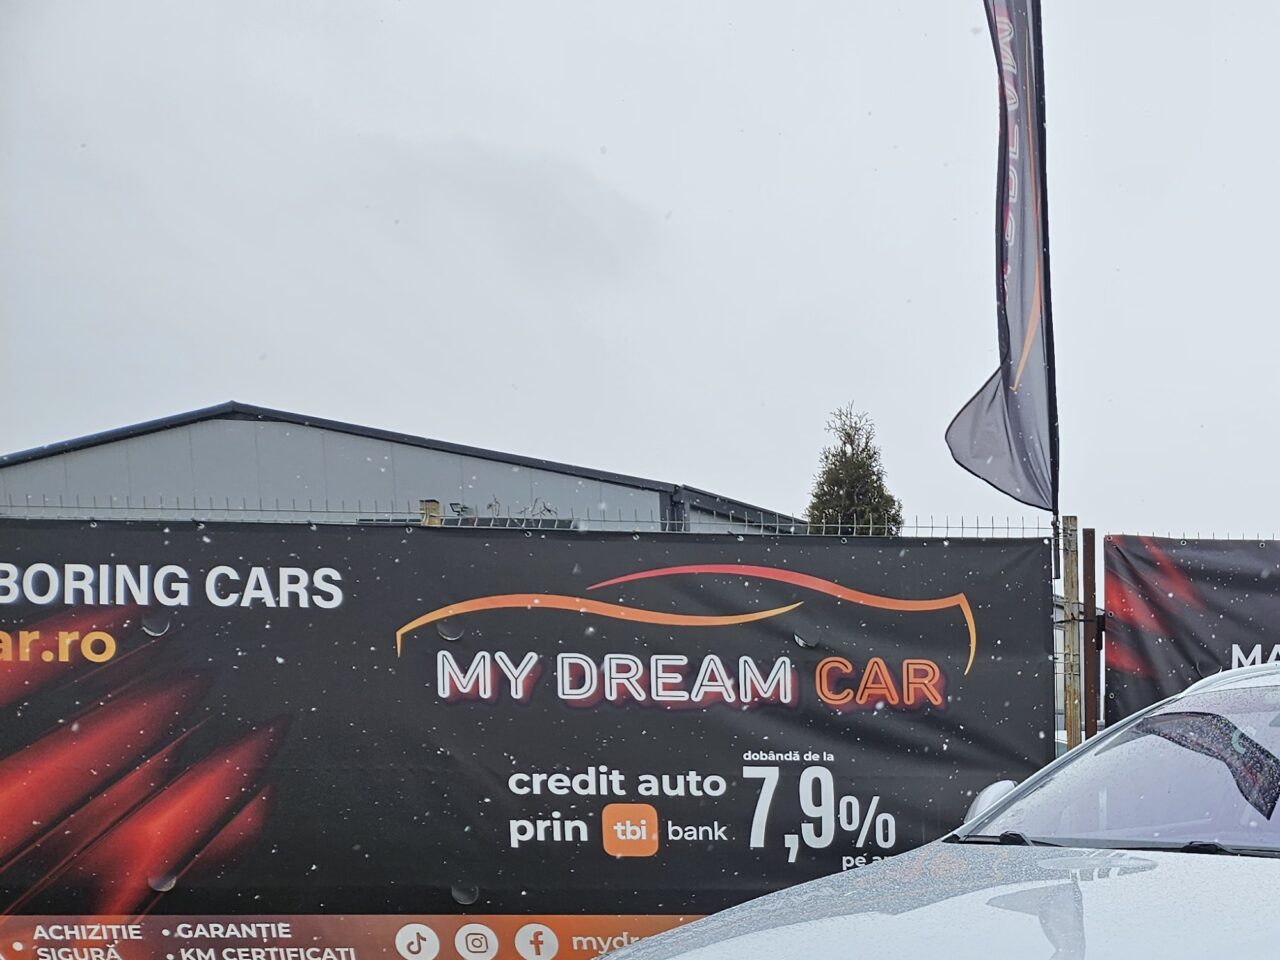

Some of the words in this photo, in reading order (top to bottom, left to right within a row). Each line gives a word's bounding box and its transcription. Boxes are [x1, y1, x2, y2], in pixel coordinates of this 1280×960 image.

[205, 565, 344, 609] CARS
[437, 650, 538, 699] MY
[557, 652, 792, 703] DREAM
[815, 656, 942, 706] CAR
[743, 750, 800, 762] dobândă
[803, 751, 820, 762] de
[823, 752, 835, 762] la
[508, 765, 626, 796] credit
[637, 770, 727, 797] auto
[509, 811, 588, 849] prin
[613, 819, 647, 841] tbi
[667, 820, 728, 841] bank
[33, 924, 144, 945] ACHIZIȚIE
[176, 923, 293, 943] GARANȚIE
[572, 932, 650, 955] mydr
